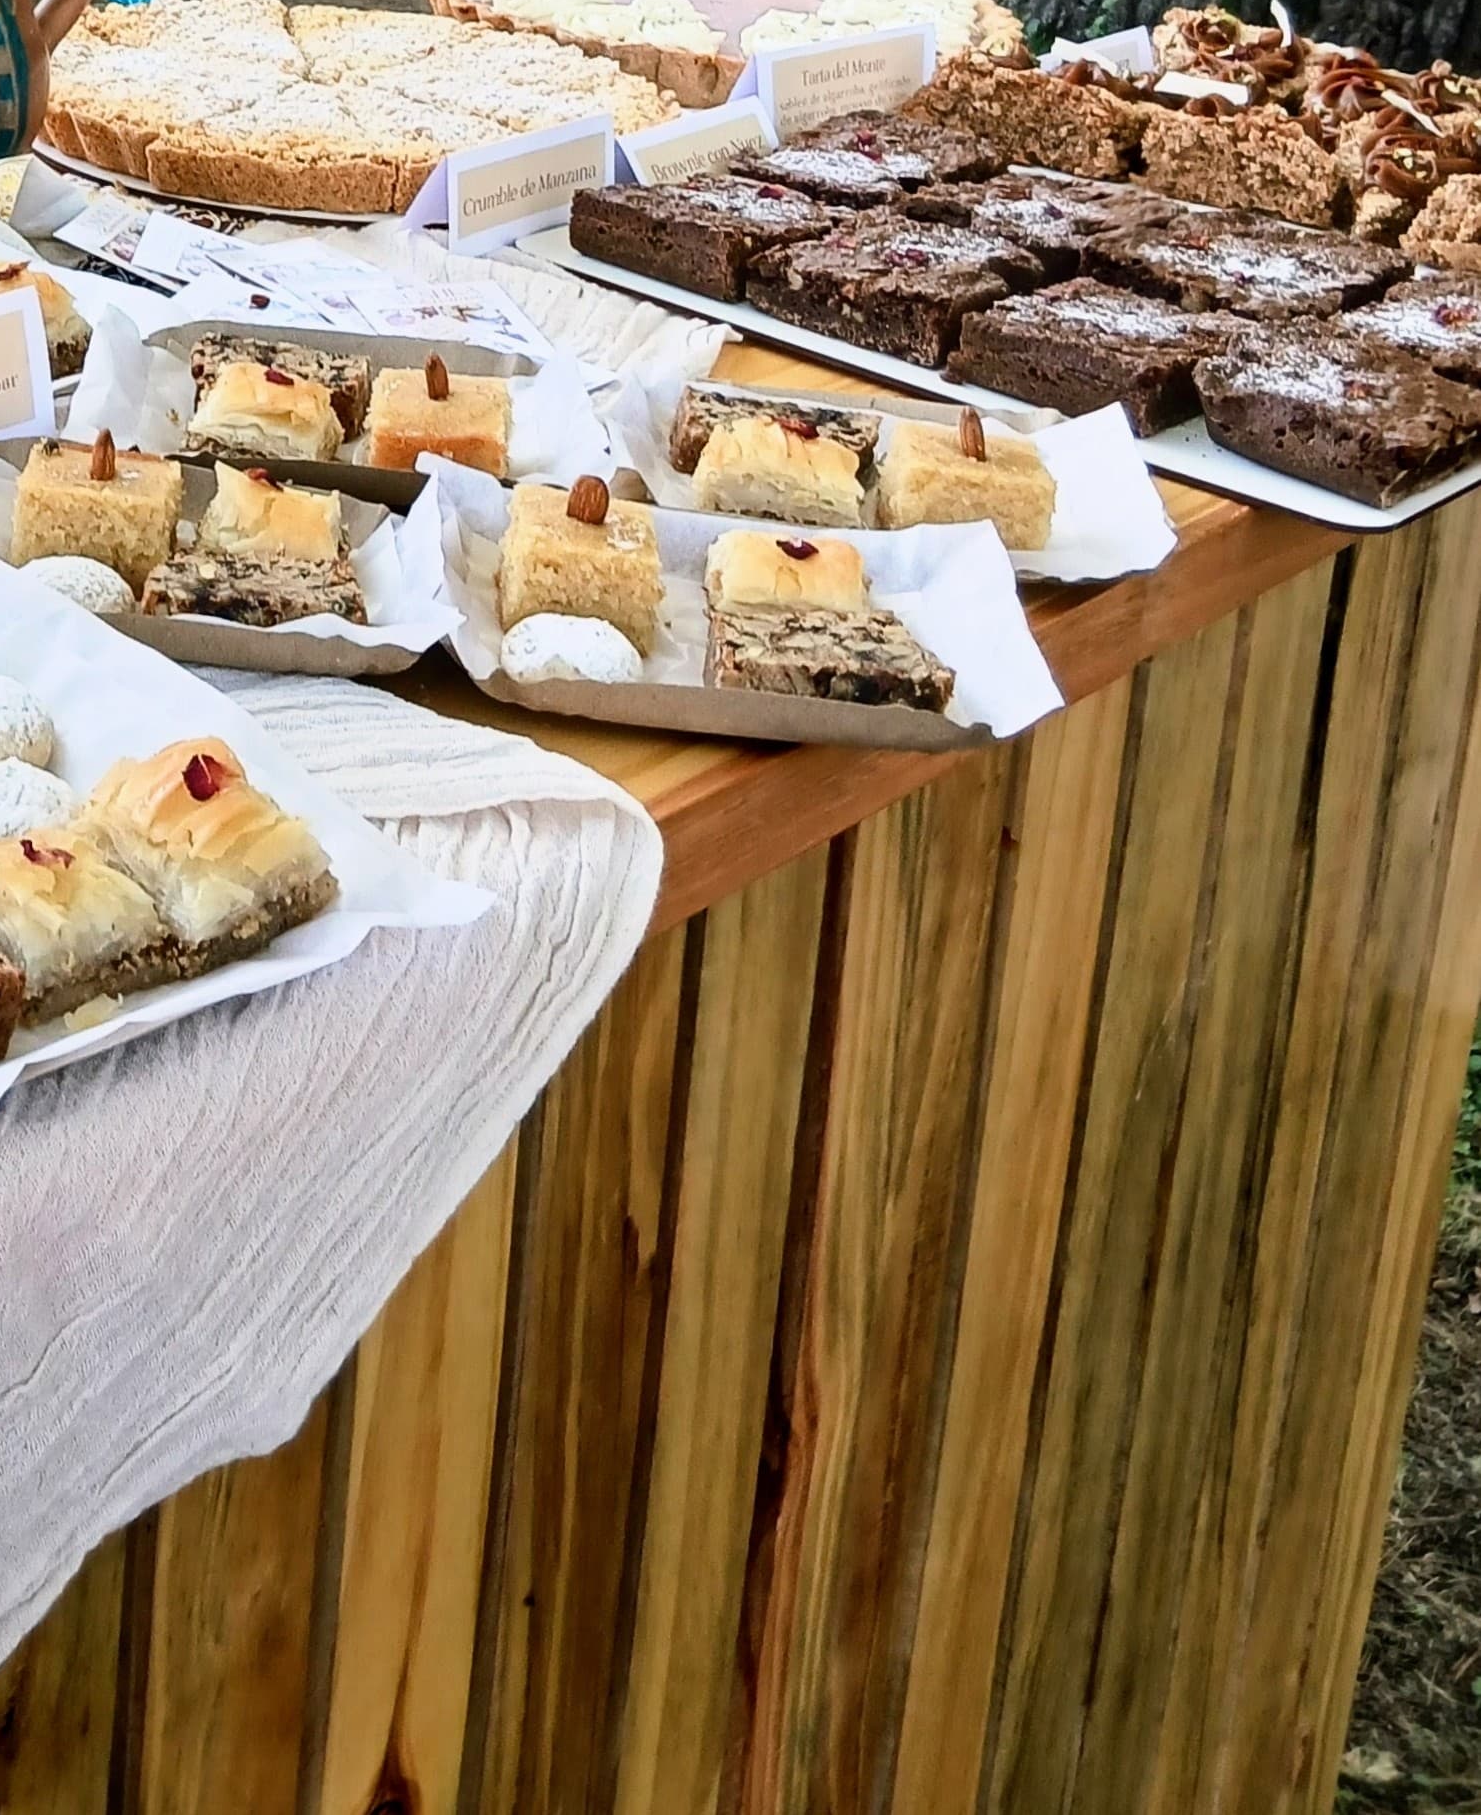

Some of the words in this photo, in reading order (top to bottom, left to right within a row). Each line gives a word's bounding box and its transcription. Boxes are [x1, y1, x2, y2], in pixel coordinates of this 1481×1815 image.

[651, 150, 706, 182] Brownie
[707, 145, 730, 165] con
[462, 182, 519, 217] Crumble
[520, 177, 537, 199] de
[538, 164, 597, 193] Manzana
